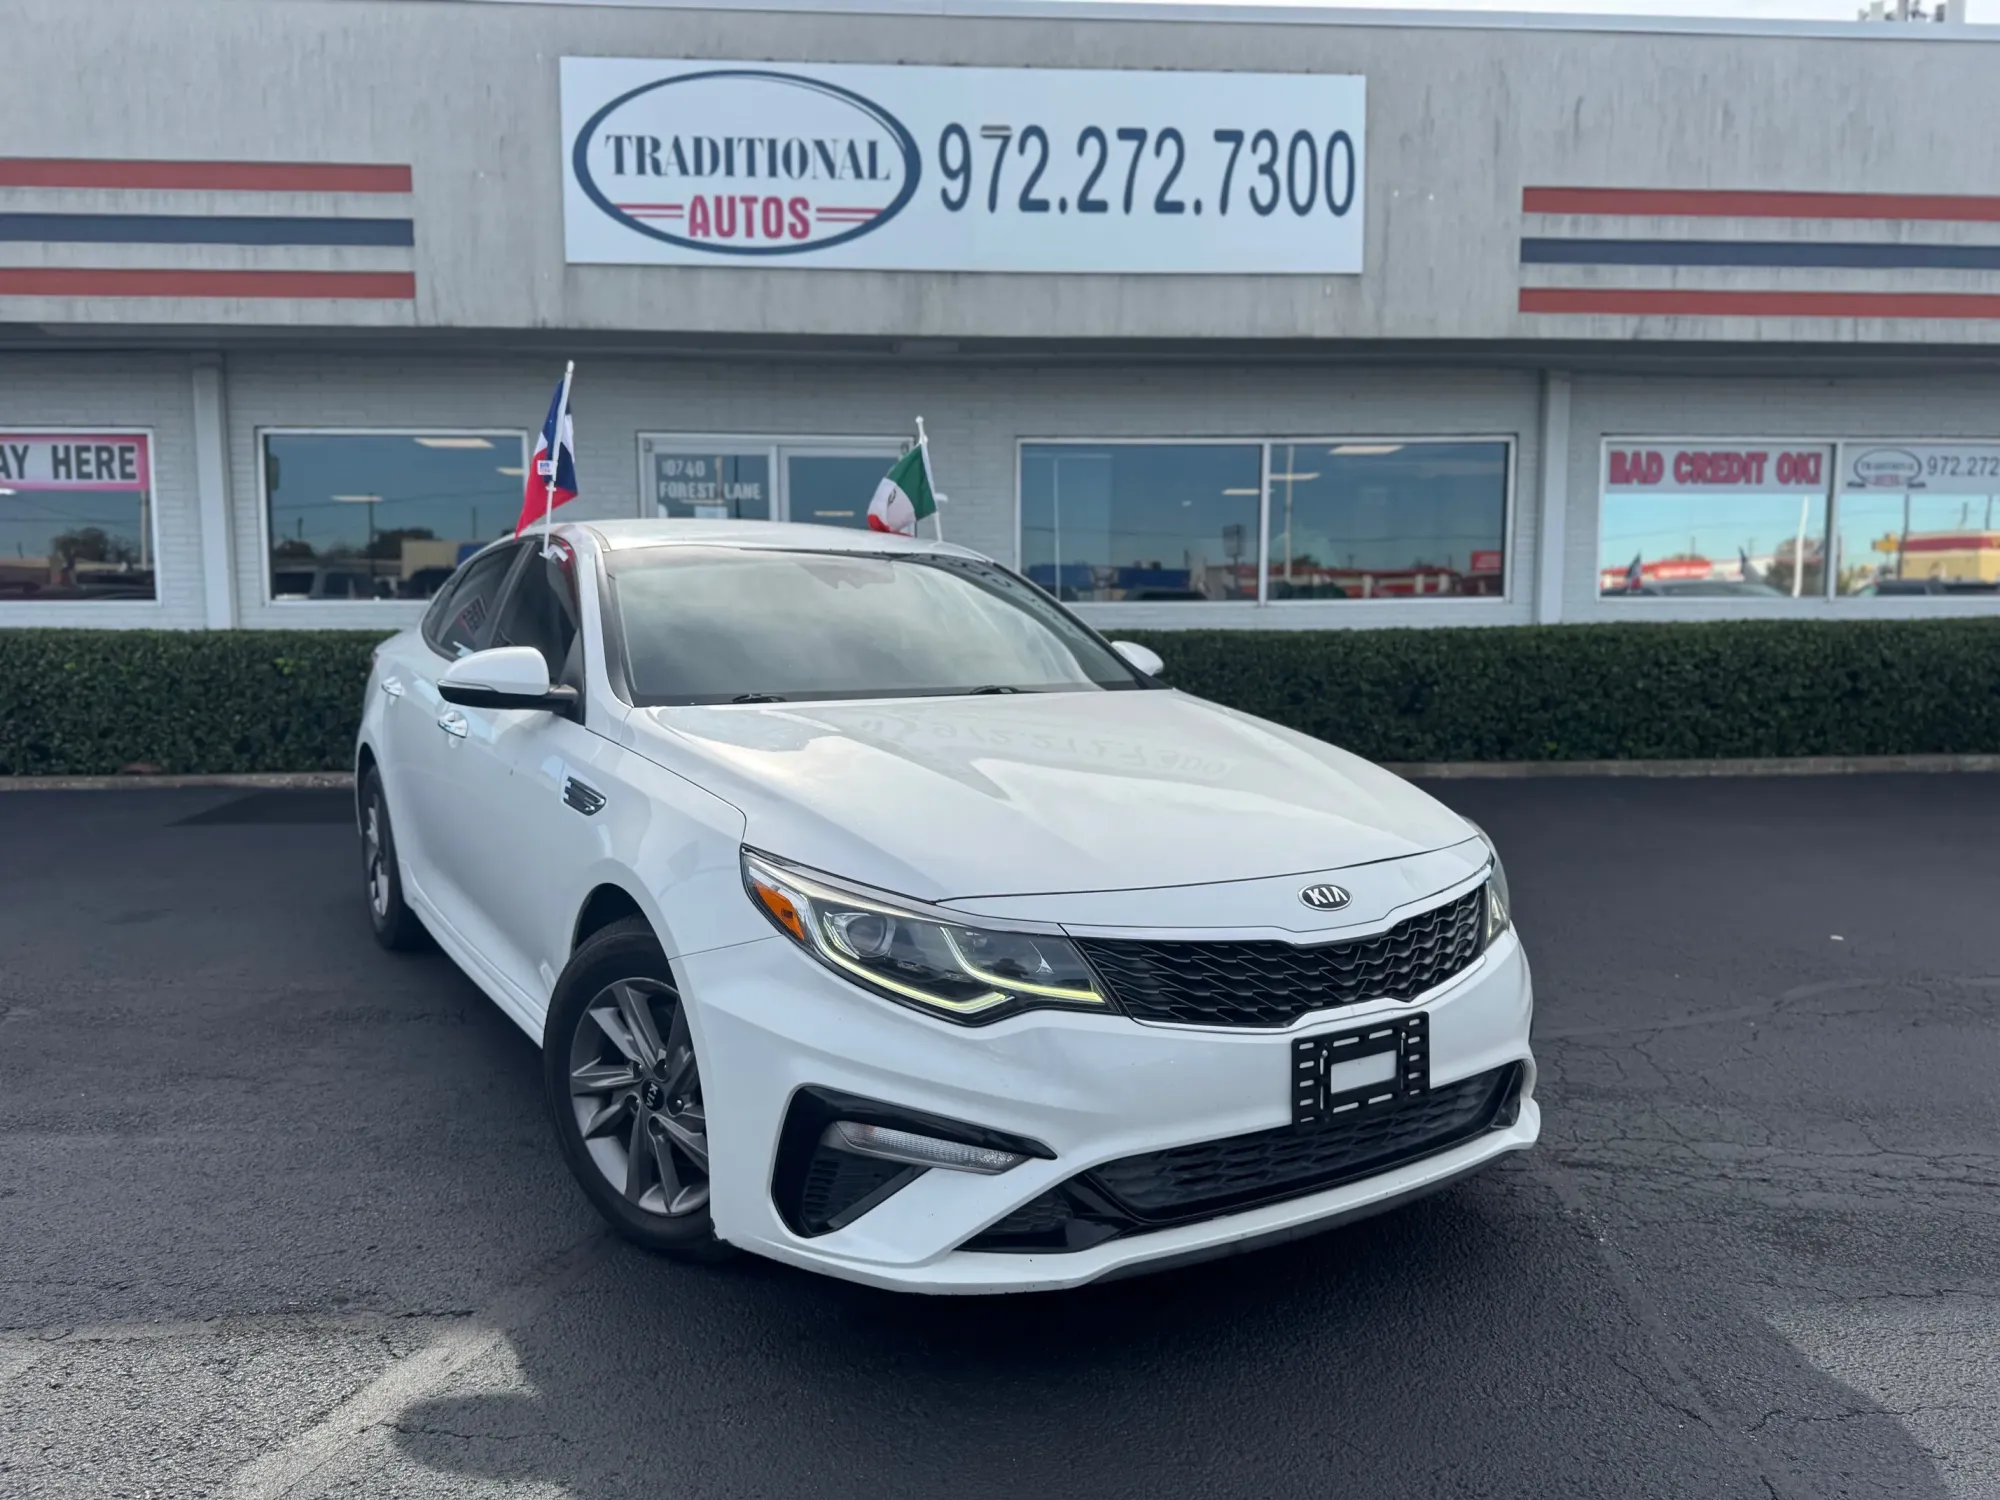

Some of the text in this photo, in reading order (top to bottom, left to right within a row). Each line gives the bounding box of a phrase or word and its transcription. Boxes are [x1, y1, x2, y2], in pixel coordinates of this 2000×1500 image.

[605, 134, 891, 181] TRADITIONAL
[938, 122, 1356, 217] 972.272.7300
[688, 195, 811, 240] AUTOS
[51, 444, 137, 480] HERE
[1608, 450, 1665, 485] BAD
[1672, 451, 1769, 485] CREDIT
[659, 481, 761, 500] FOREST LANE
[1305, 886, 1348, 905] KIA
